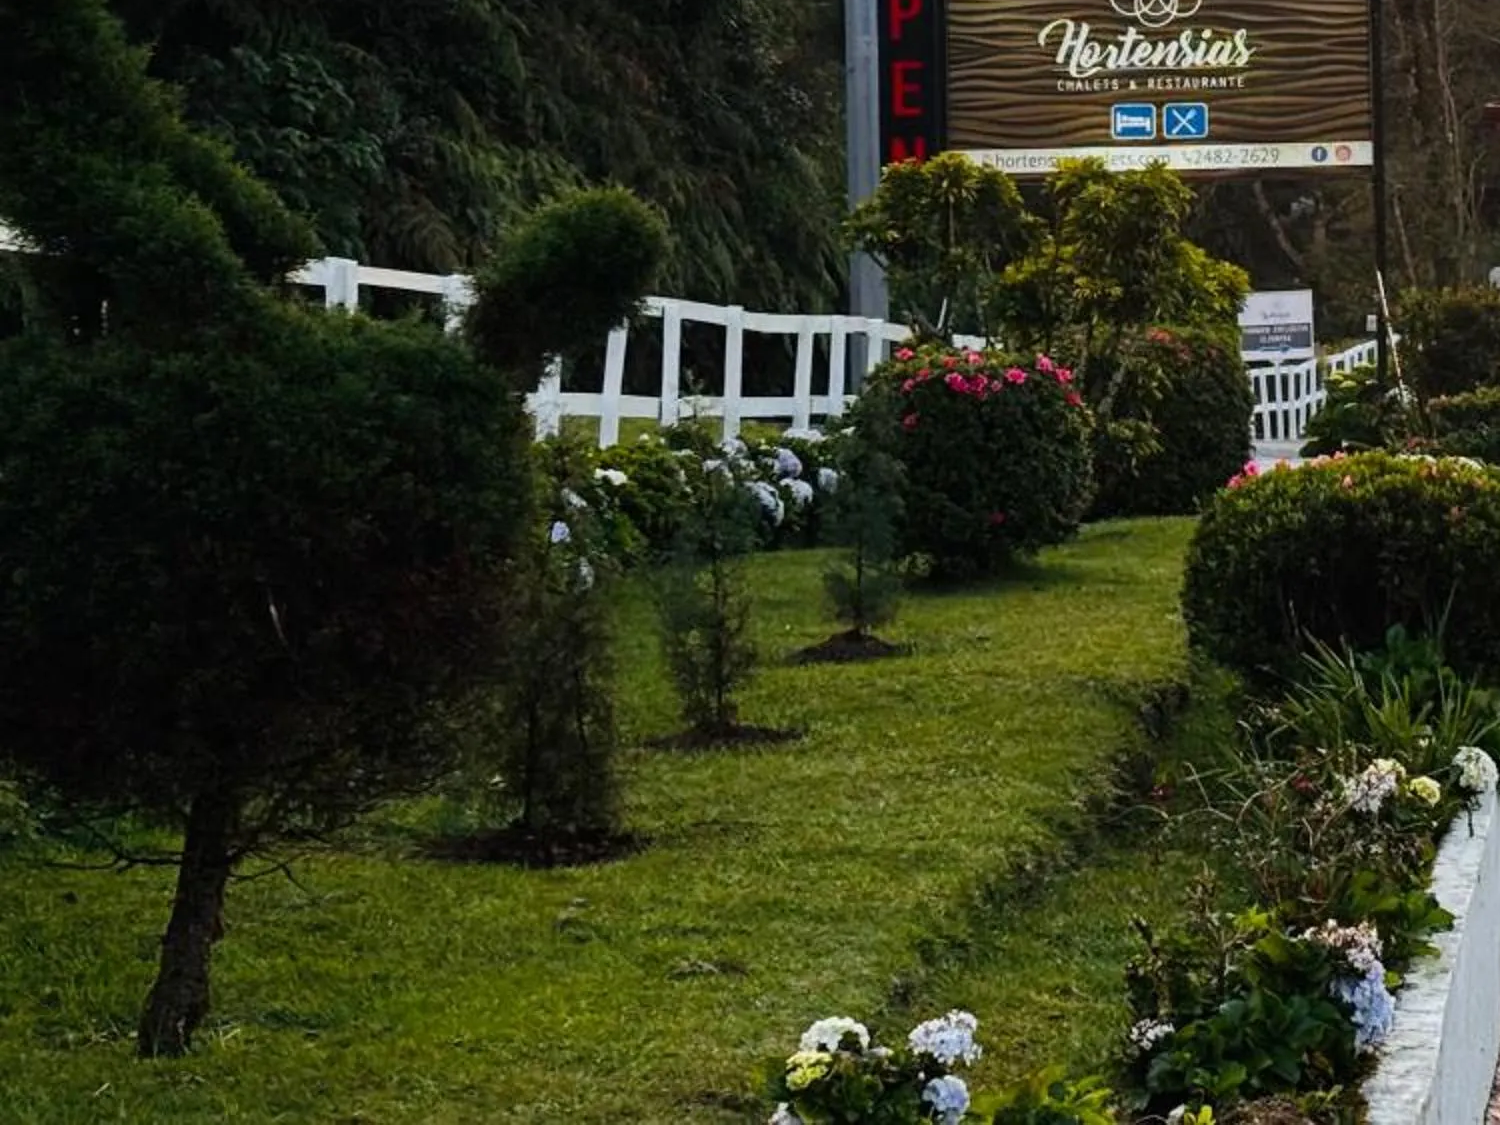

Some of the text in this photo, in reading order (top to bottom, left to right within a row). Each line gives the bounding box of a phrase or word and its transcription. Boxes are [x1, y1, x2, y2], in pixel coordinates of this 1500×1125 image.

[1038, 19, 1257, 78] Hortensias
[1057, 78, 1119, 91] CHALETS
[1147, 77, 1245, 90] RESTAURANTE
[1193, 147, 1280, 166] 2482-2629
